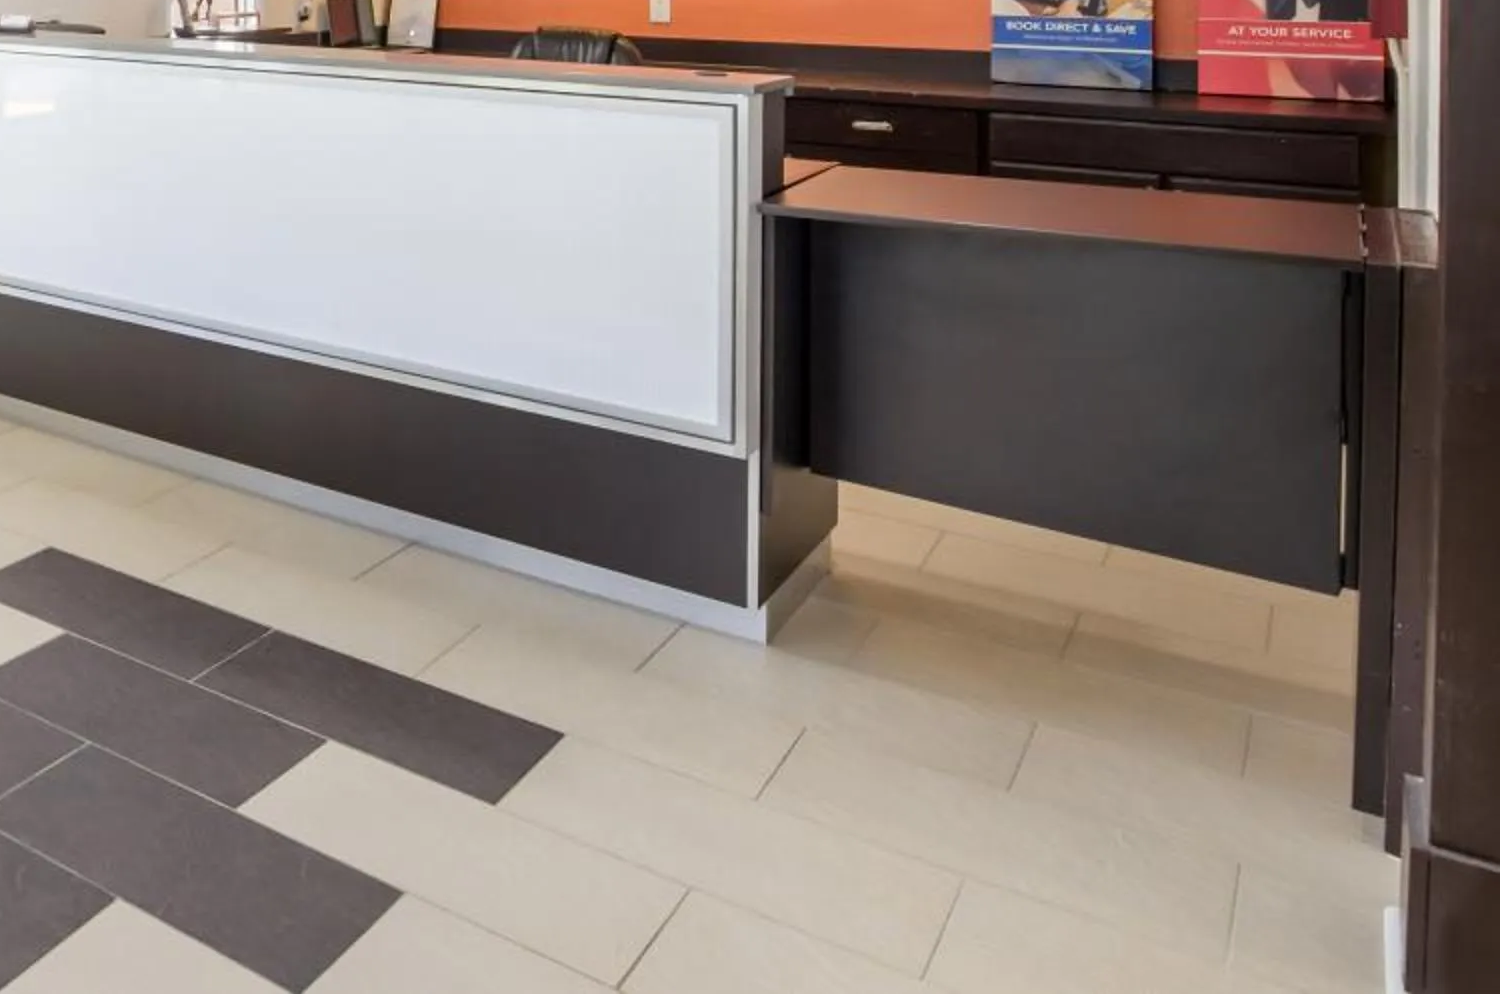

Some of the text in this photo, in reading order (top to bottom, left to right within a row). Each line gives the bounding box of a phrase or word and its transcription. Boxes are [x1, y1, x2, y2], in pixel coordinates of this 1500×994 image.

[1005, 21, 1137, 34] BOOK DIRECT & SAVE
[1228, 26, 1352, 39] AT YOUR SERVICE
